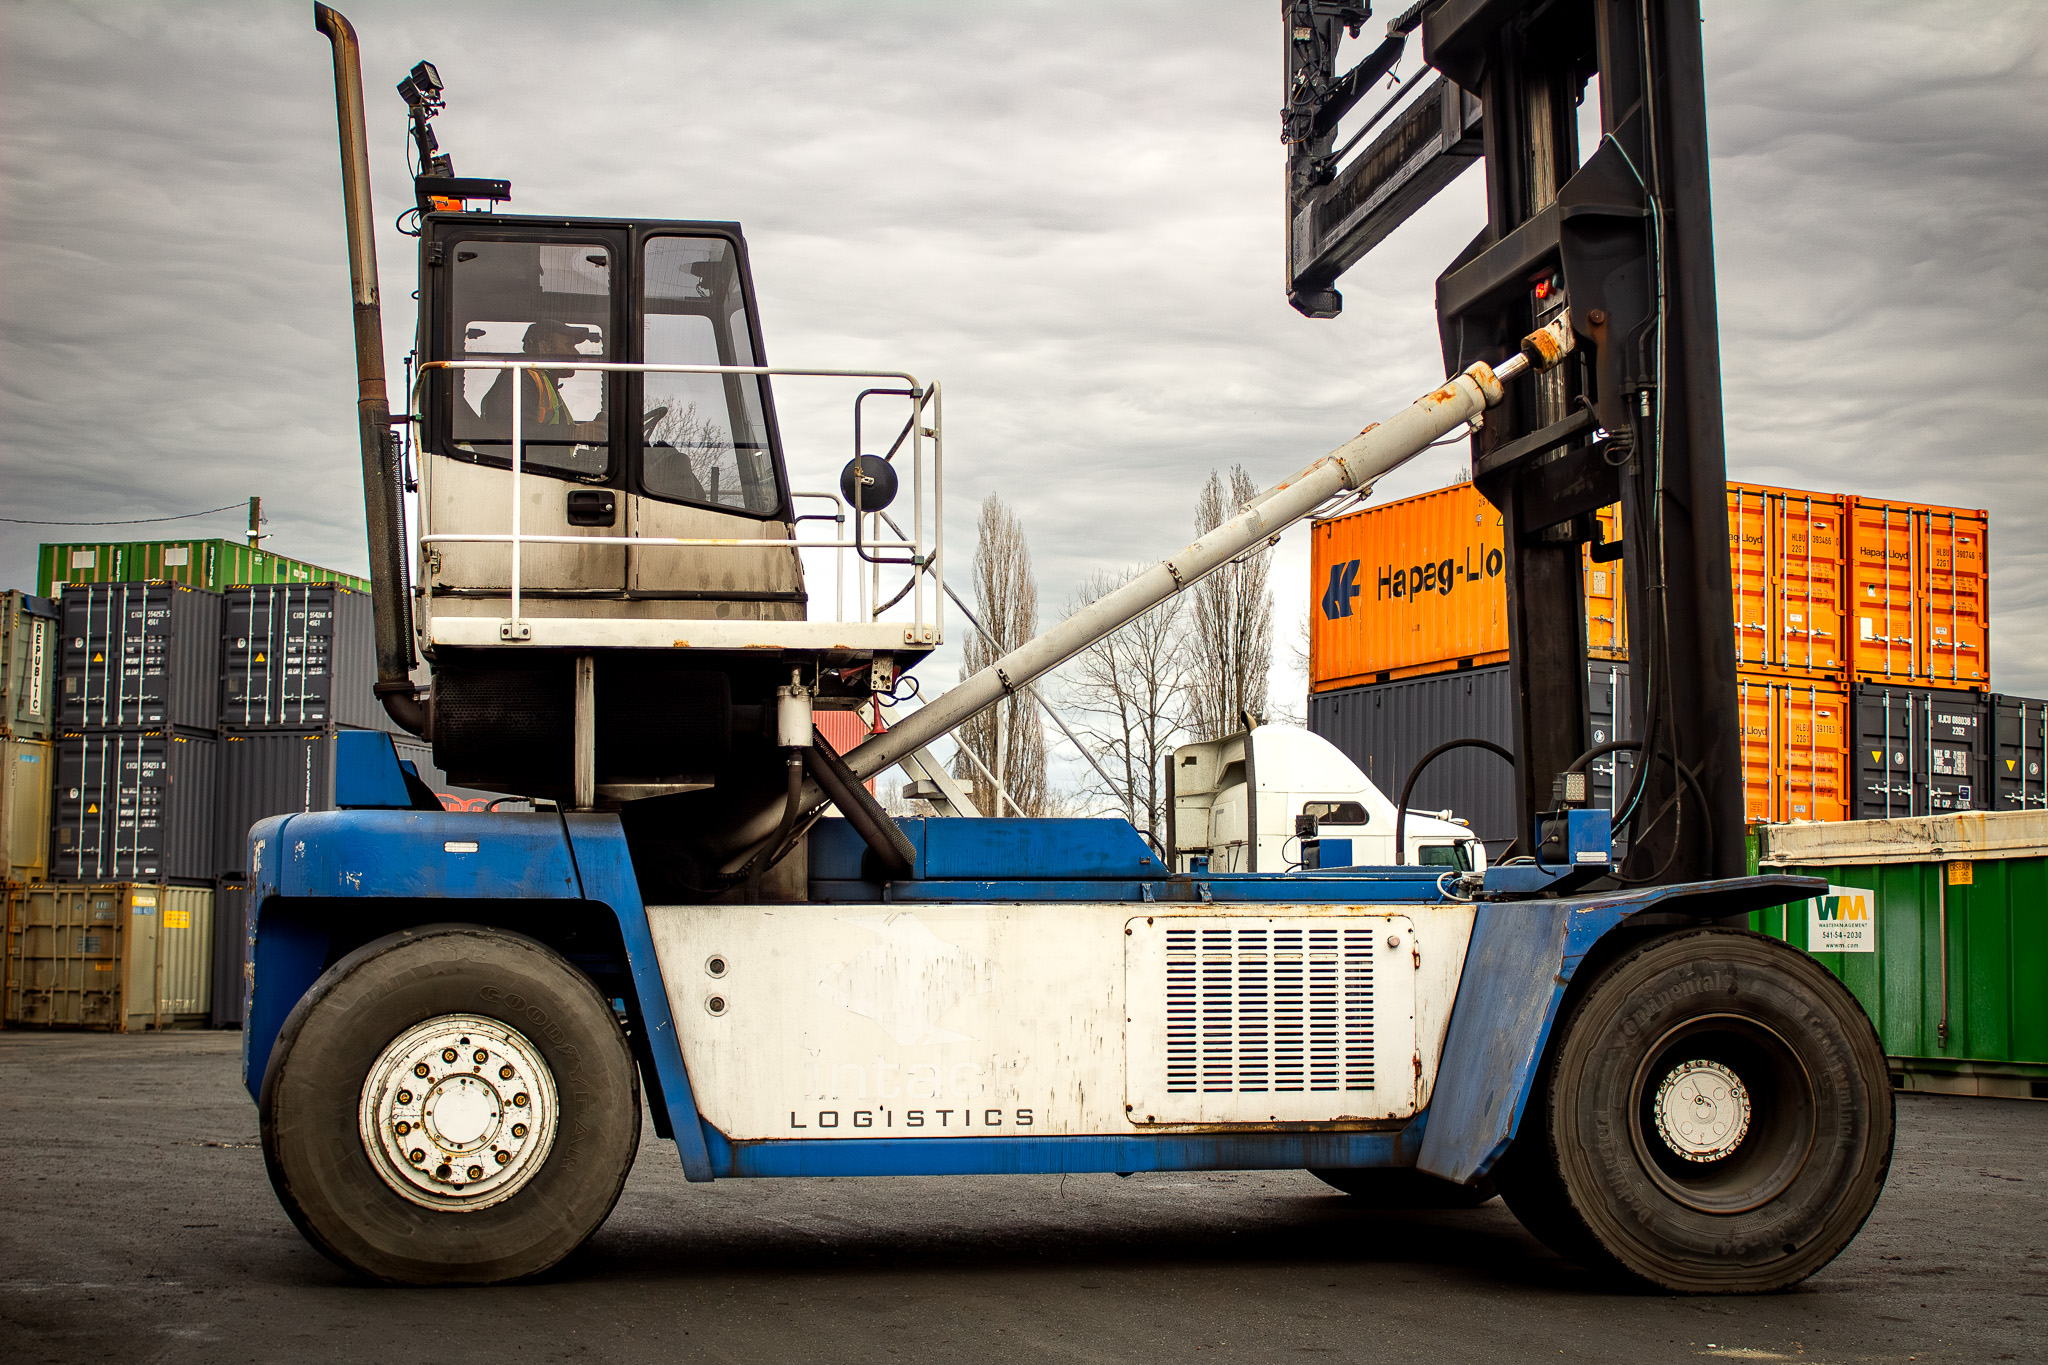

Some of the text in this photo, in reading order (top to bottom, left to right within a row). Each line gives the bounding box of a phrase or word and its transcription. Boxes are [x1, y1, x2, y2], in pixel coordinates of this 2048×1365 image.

[1860, 546, 1909, 561] HapagLloyd
[1378, 543, 1504, 603] Hapag-Llo
[33, 623, 42, 709] REPUBLIC
[1815, 896, 1867, 920] WM
[791, 1108, 1034, 1128] LOGISTICS
